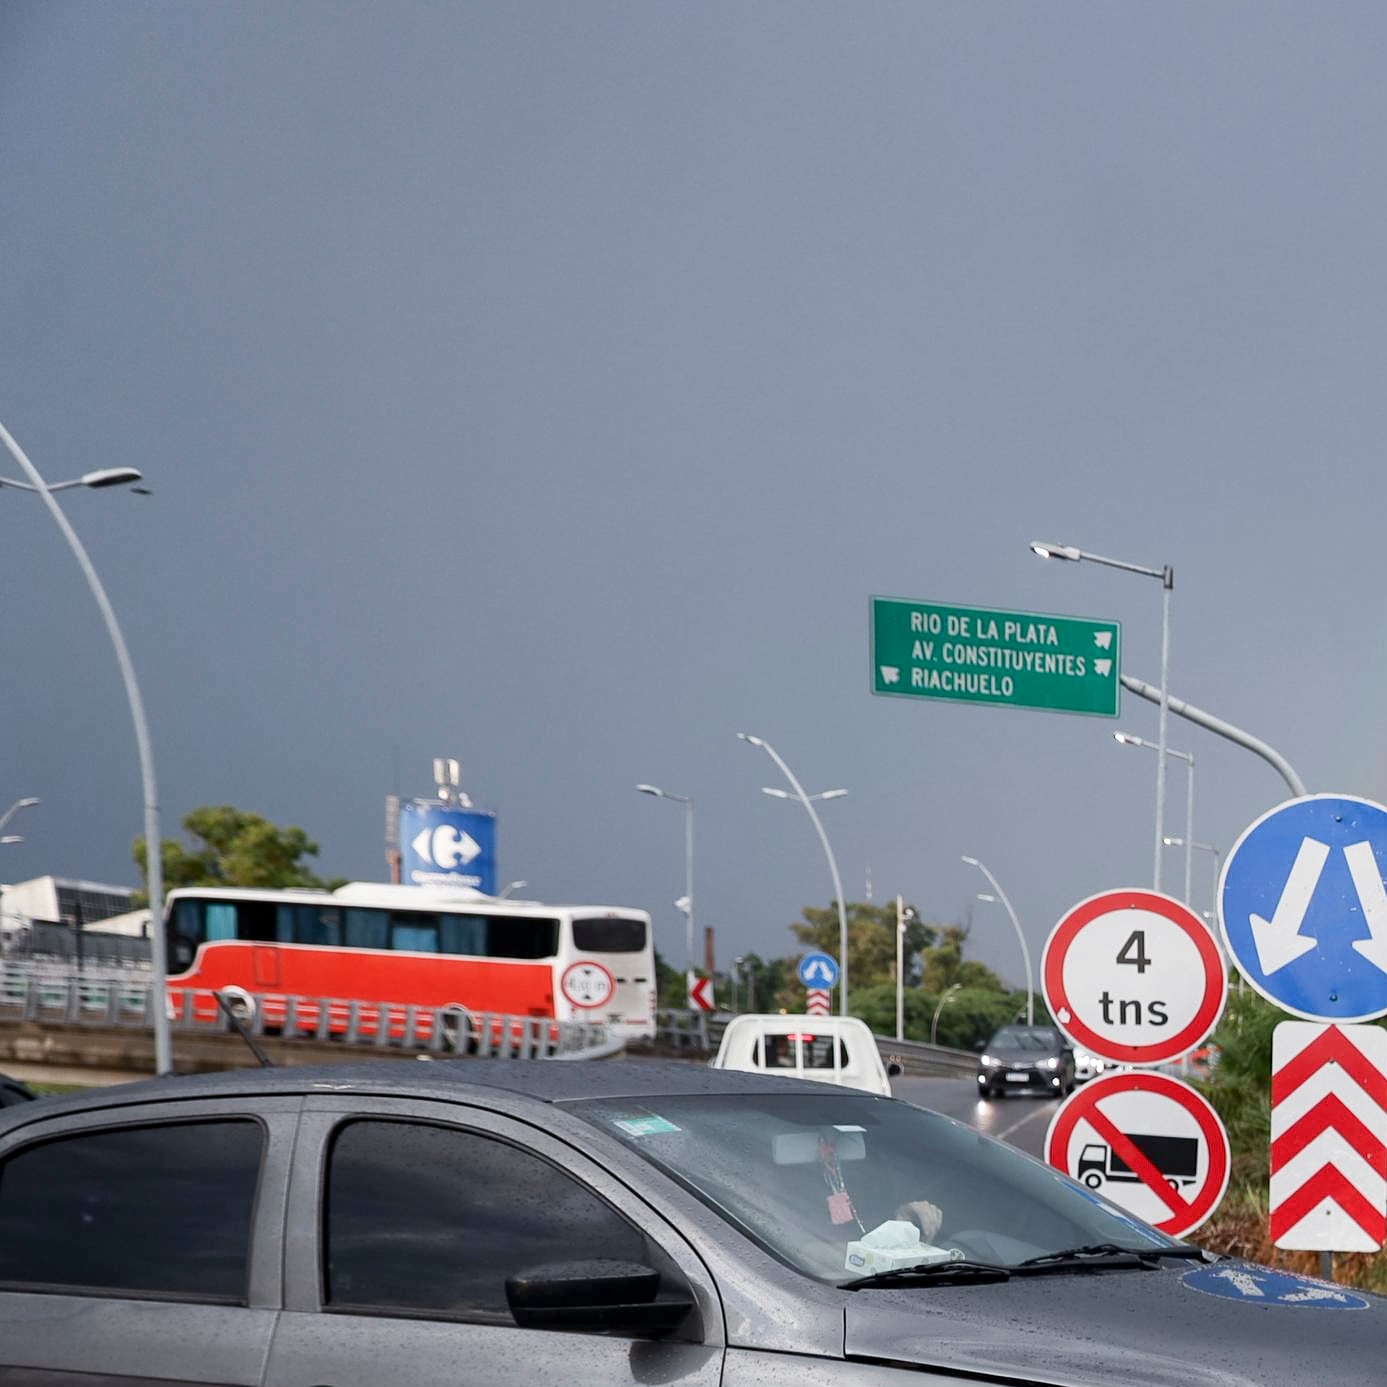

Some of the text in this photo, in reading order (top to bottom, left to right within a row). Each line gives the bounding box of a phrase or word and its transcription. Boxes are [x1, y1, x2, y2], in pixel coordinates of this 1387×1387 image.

[911, 612, 1058, 646] RIO DE LA PLATA
[912, 640, 1087, 677] AV. CONSTITUYENTES
[911, 668, 1014, 696] RIACHUELO
[1116, 930, 1152, 974] 4
[1098, 991, 1169, 1026] tns
